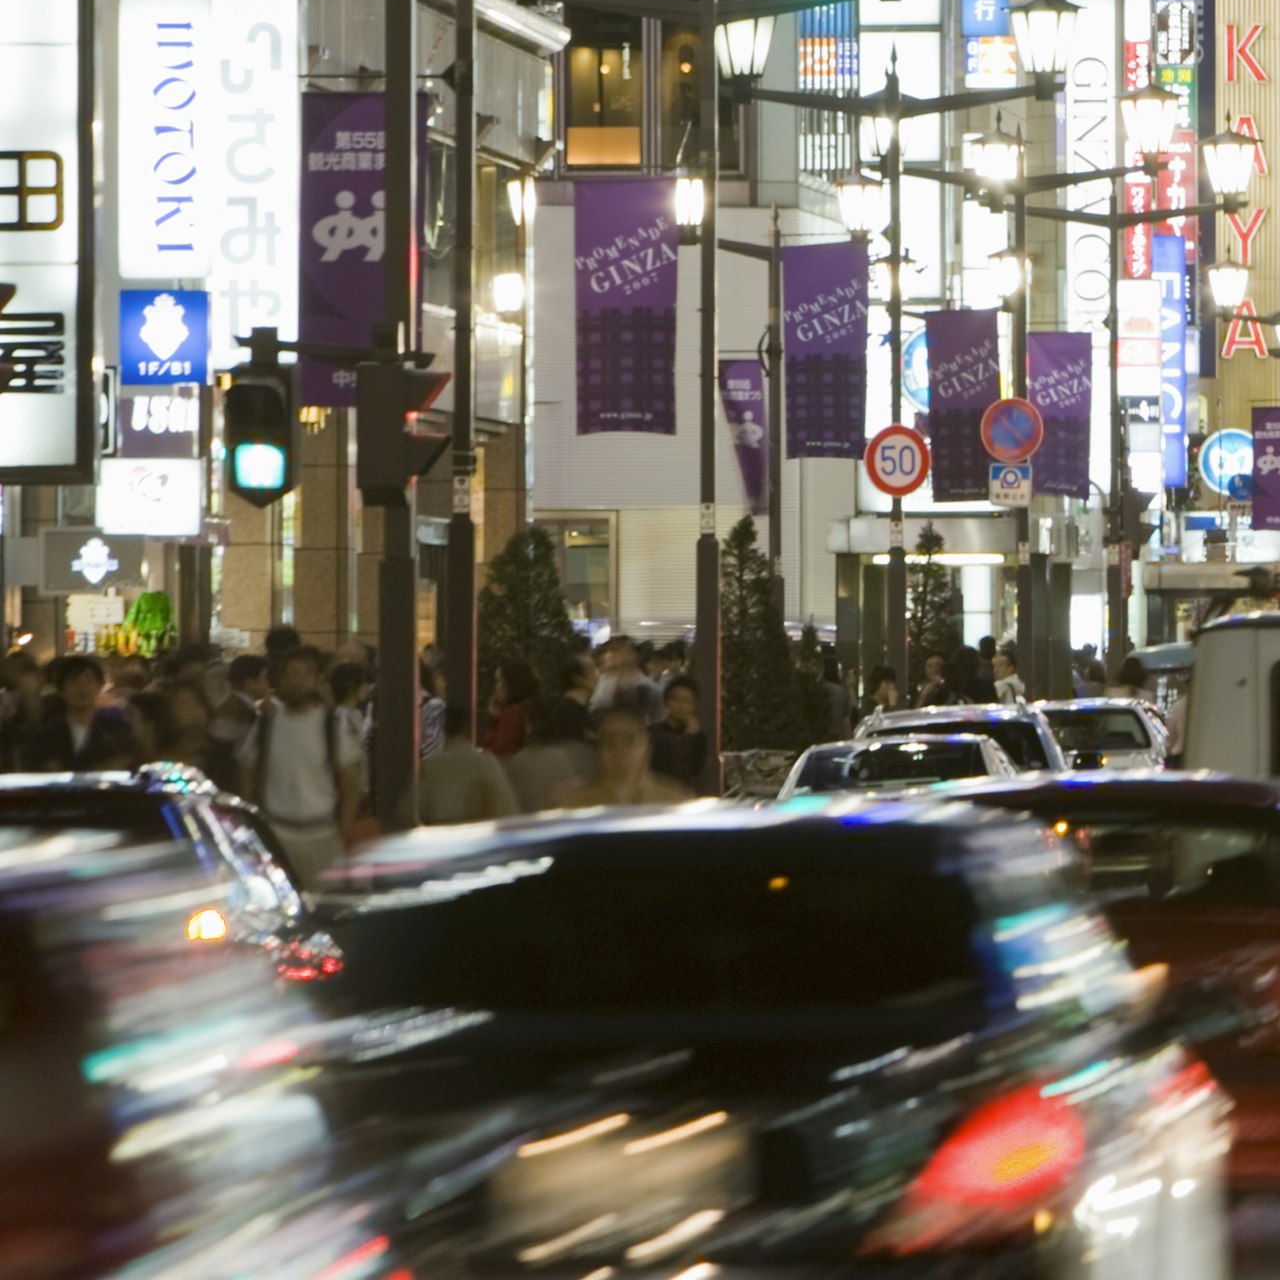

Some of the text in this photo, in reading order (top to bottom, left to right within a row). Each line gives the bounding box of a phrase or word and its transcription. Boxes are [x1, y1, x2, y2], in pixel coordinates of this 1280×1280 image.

[575, 216, 678, 296] PROMENADE GINZA 2007
[784, 278, 869, 344] PROMENADE GINZA 2007
[137, 360, 193, 377] 1F/B1
[937, 360, 1000, 398] GINZA
[962, 380, 988, 400] 2007
[1035, 378, 1092, 407] GINZA
[880, 446, 917, 476] 50
